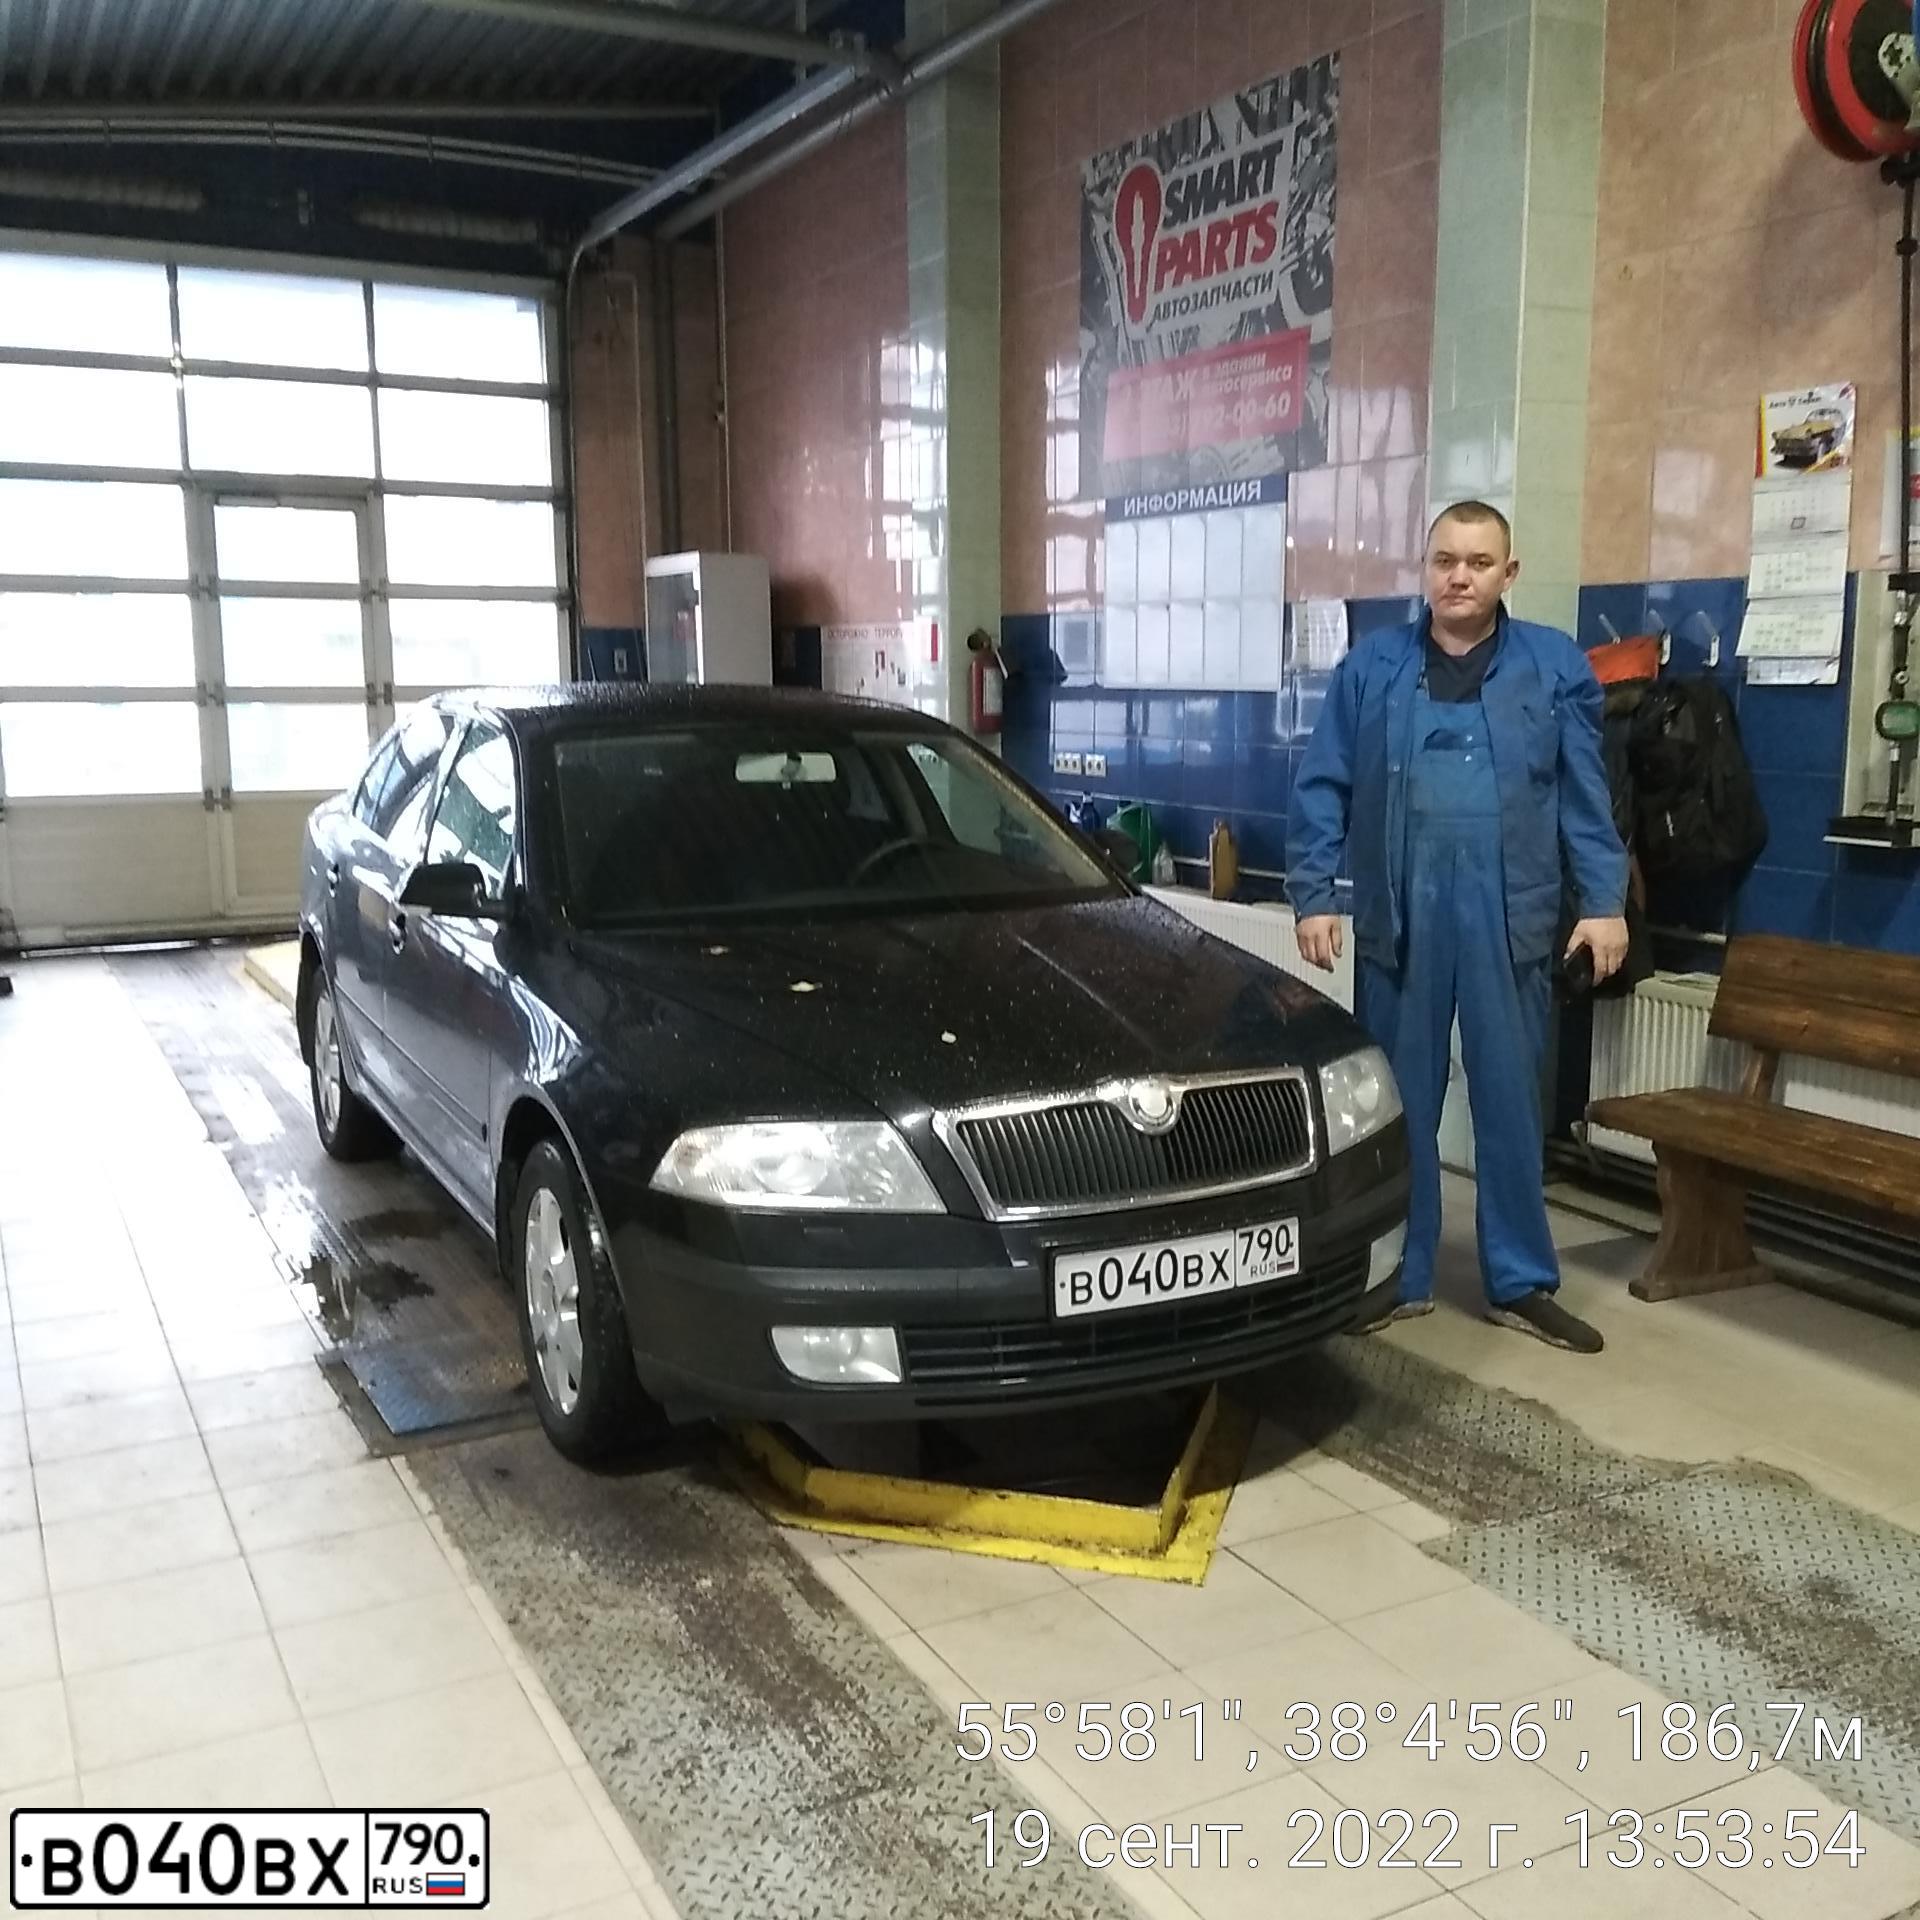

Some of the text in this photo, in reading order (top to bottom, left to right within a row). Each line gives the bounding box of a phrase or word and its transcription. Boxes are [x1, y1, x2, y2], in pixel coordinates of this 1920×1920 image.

[1163, 139, 1284, 229] SMART
[1153, 201, 1279, 293] PARTS
[1151, 270, 1274, 324] АВТОЗАПЧАСТИ
[1123, 479, 1262, 517] ИНФОРМАЦИЯ
[1070, 1224, 1291, 1306] В040ВХ 790
[1250, 1263, 1276, 1278] RUS
